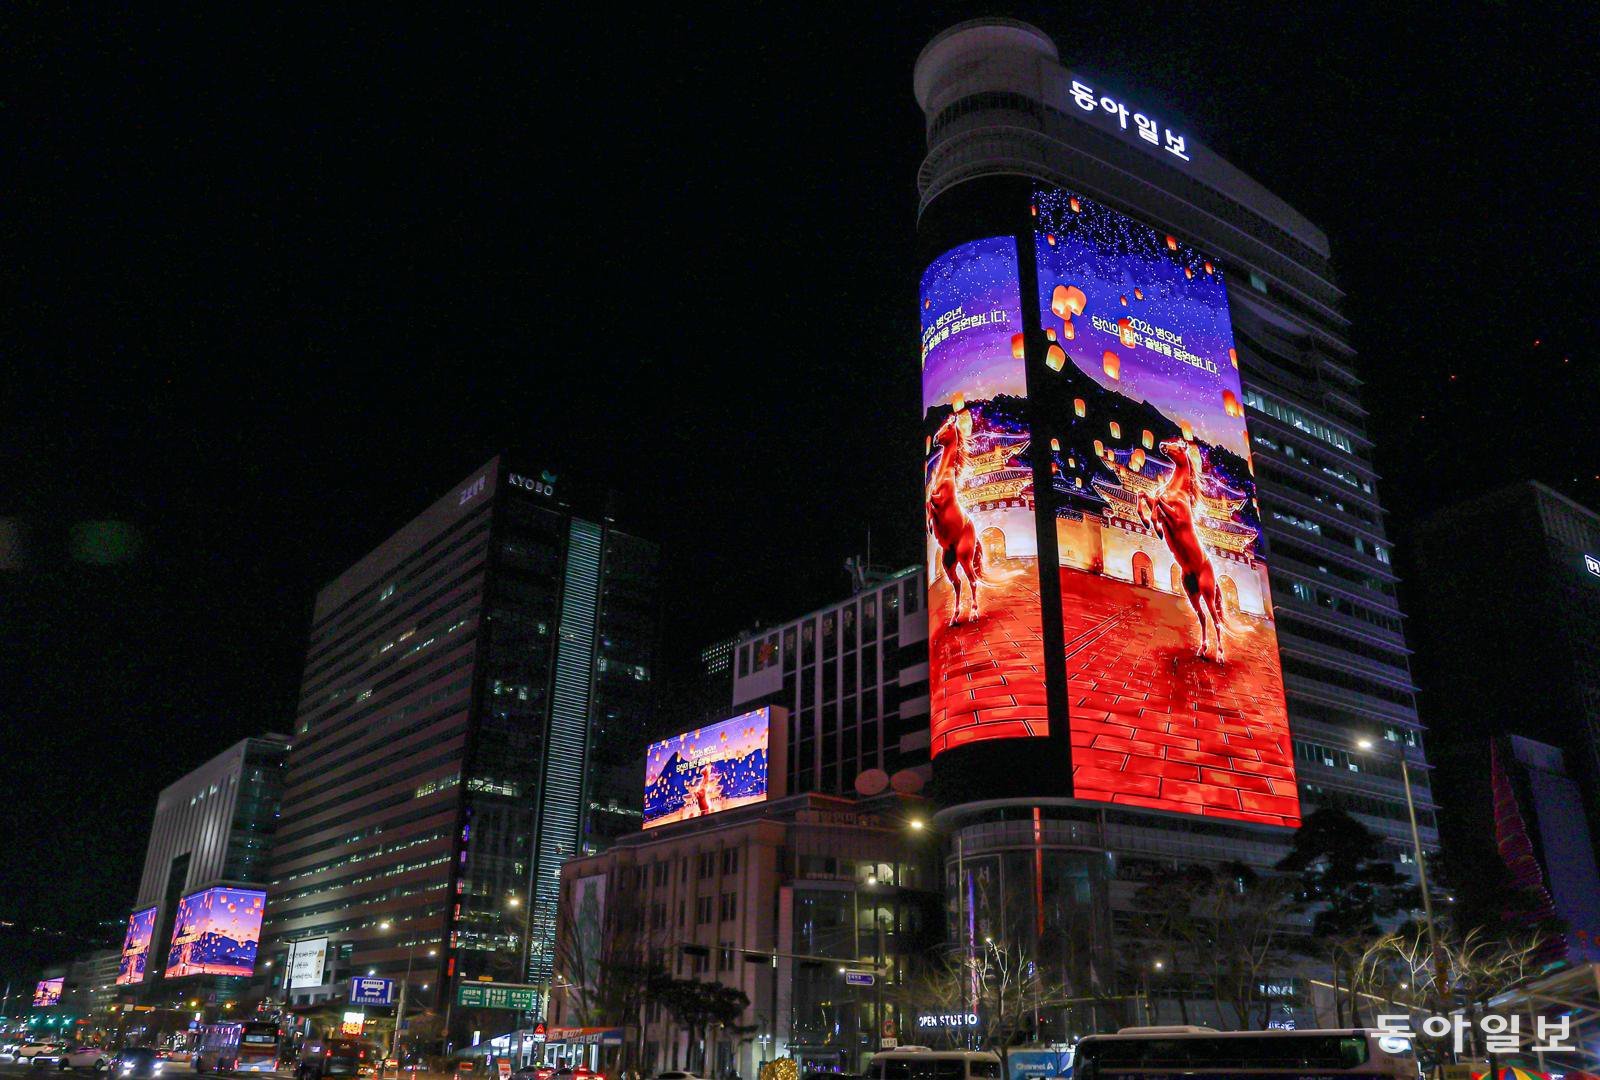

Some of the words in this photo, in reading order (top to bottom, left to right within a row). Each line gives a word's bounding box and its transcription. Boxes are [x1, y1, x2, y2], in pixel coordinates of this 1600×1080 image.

[1069, 80, 1190, 162] 동아일보
[1091, 315, 1121, 337] 당신의
[1127, 316, 1154, 336] 2026
[508, 473, 553, 496] KYOBO
[919, 1015, 938, 1027] OPEN
